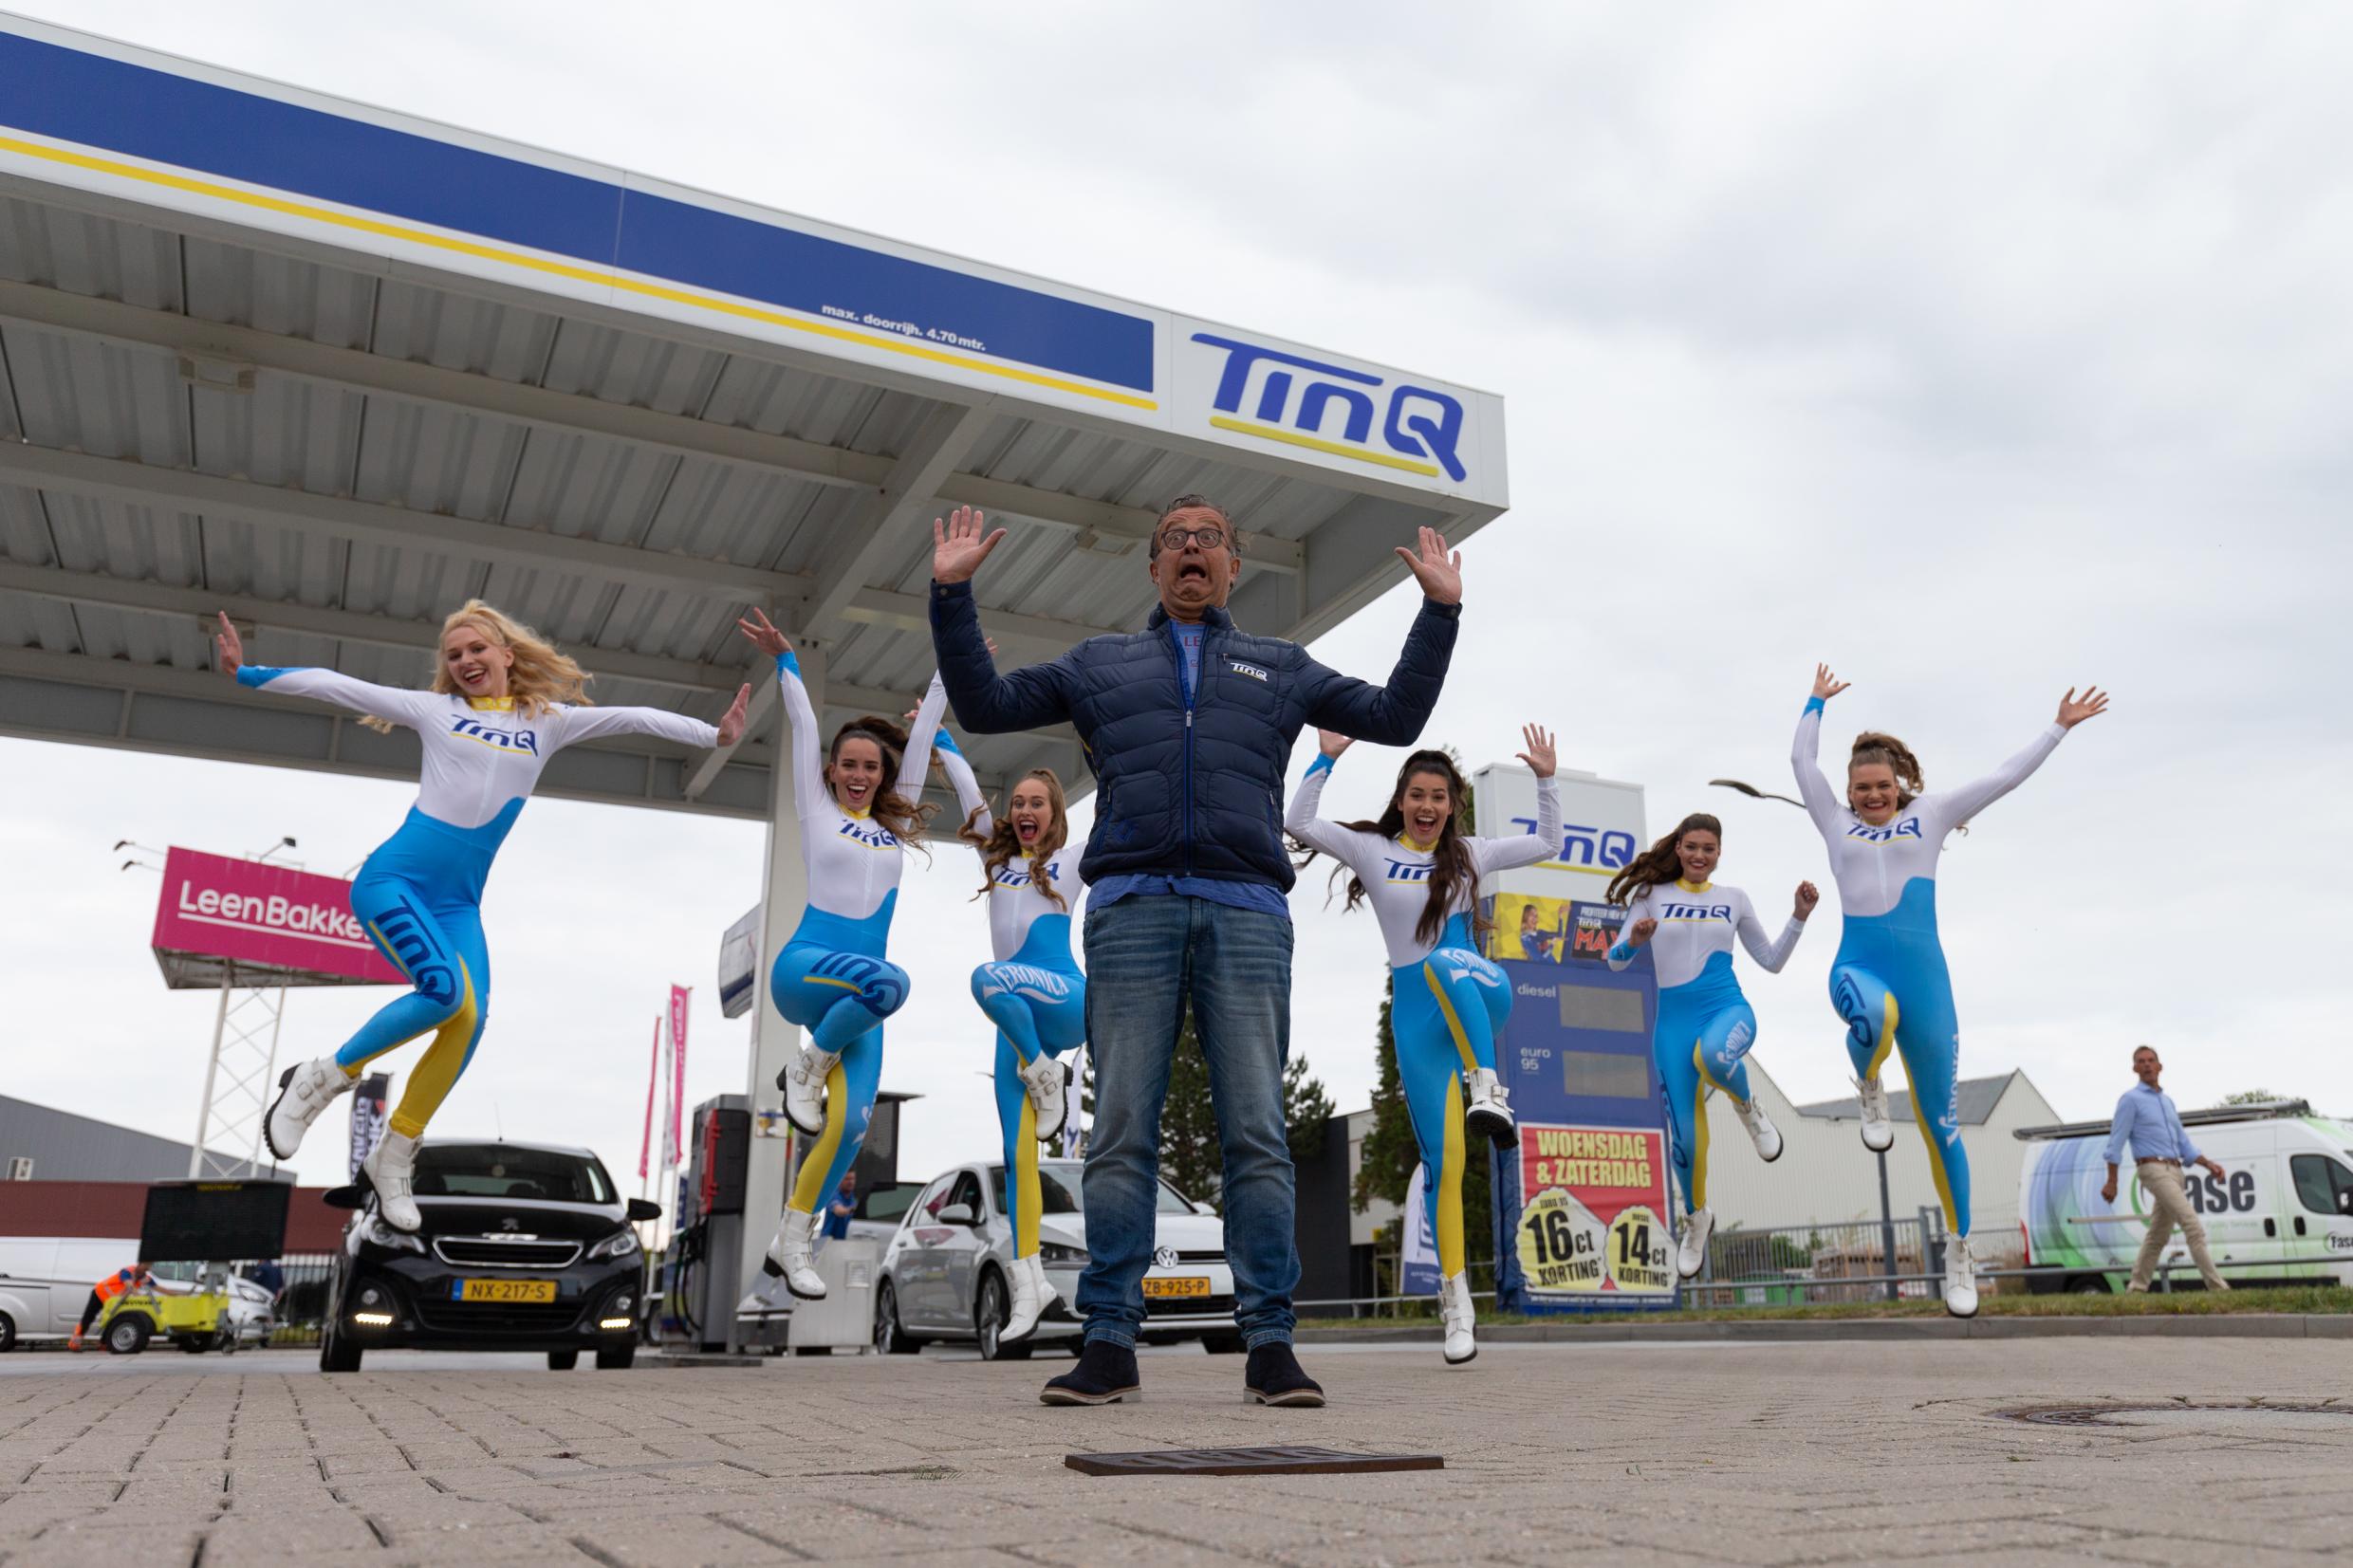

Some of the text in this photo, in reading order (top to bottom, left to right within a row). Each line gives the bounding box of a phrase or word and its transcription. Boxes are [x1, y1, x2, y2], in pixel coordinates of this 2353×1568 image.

[822, 304, 986, 351] max. doorrijh. 4.70 mtr.
[1518, 984, 1557, 998] diesel
[1520, 1046, 1551, 1059] euro
[1521, 1059, 1540, 1071] 95
[1536, 1130, 1648, 1160] WOENSDAG
[1536, 1159, 1652, 1188] & ZATERDAG
[471, 1283, 547, 1300] NX-217-S
